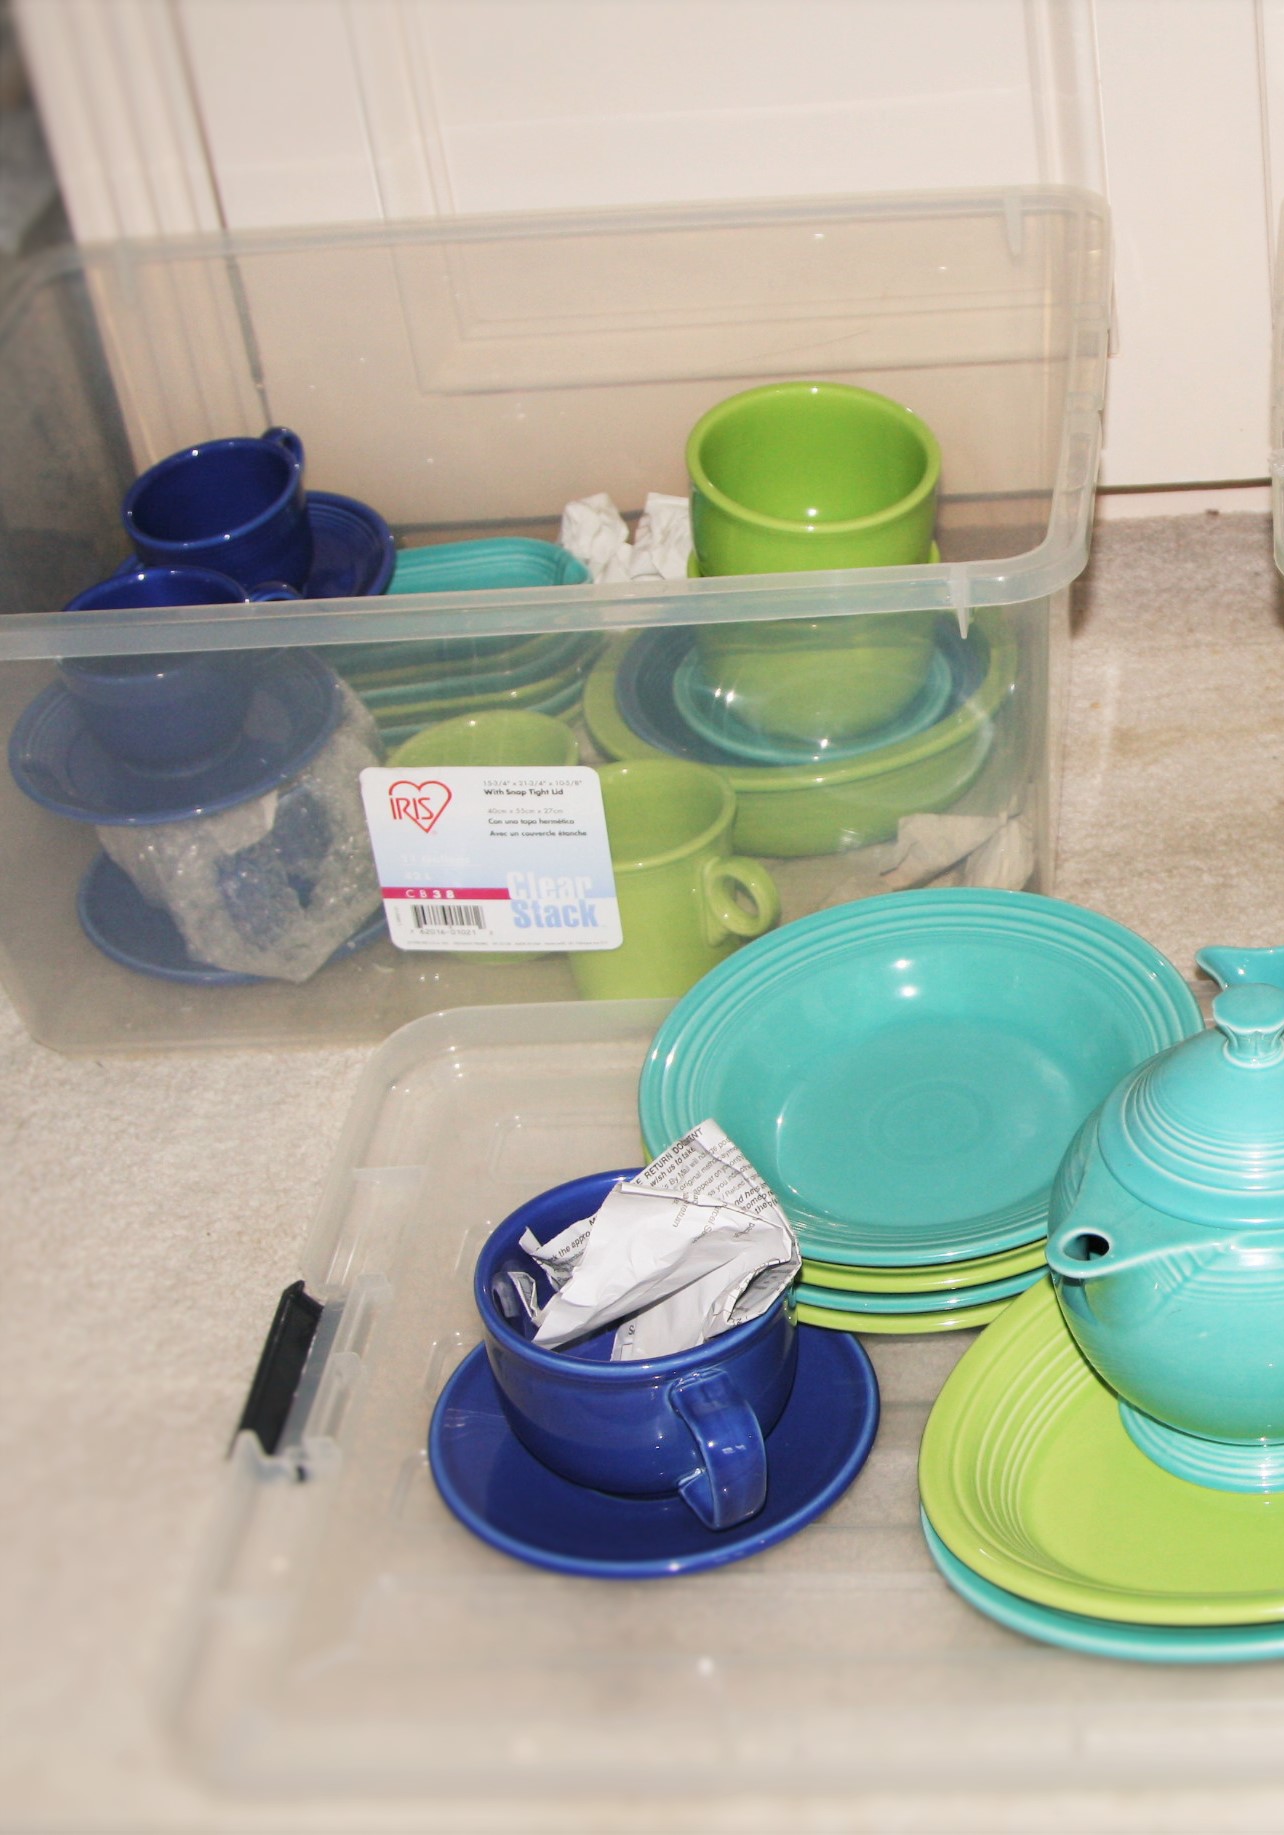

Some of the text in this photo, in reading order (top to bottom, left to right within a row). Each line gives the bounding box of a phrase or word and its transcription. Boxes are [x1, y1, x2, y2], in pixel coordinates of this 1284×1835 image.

[506, 788, 526, 796] Snap
[529, 788, 549, 796] Tight
[390, 797, 435, 820] IRIS
[506, 871, 593, 900] Clear
[511, 900, 599, 929] Stack
[644, 1152, 673, 1180] RETURN
[650, 1170, 667, 1187] wish
[667, 1164, 676, 1174] us
[675, 1157, 683, 1166] to
